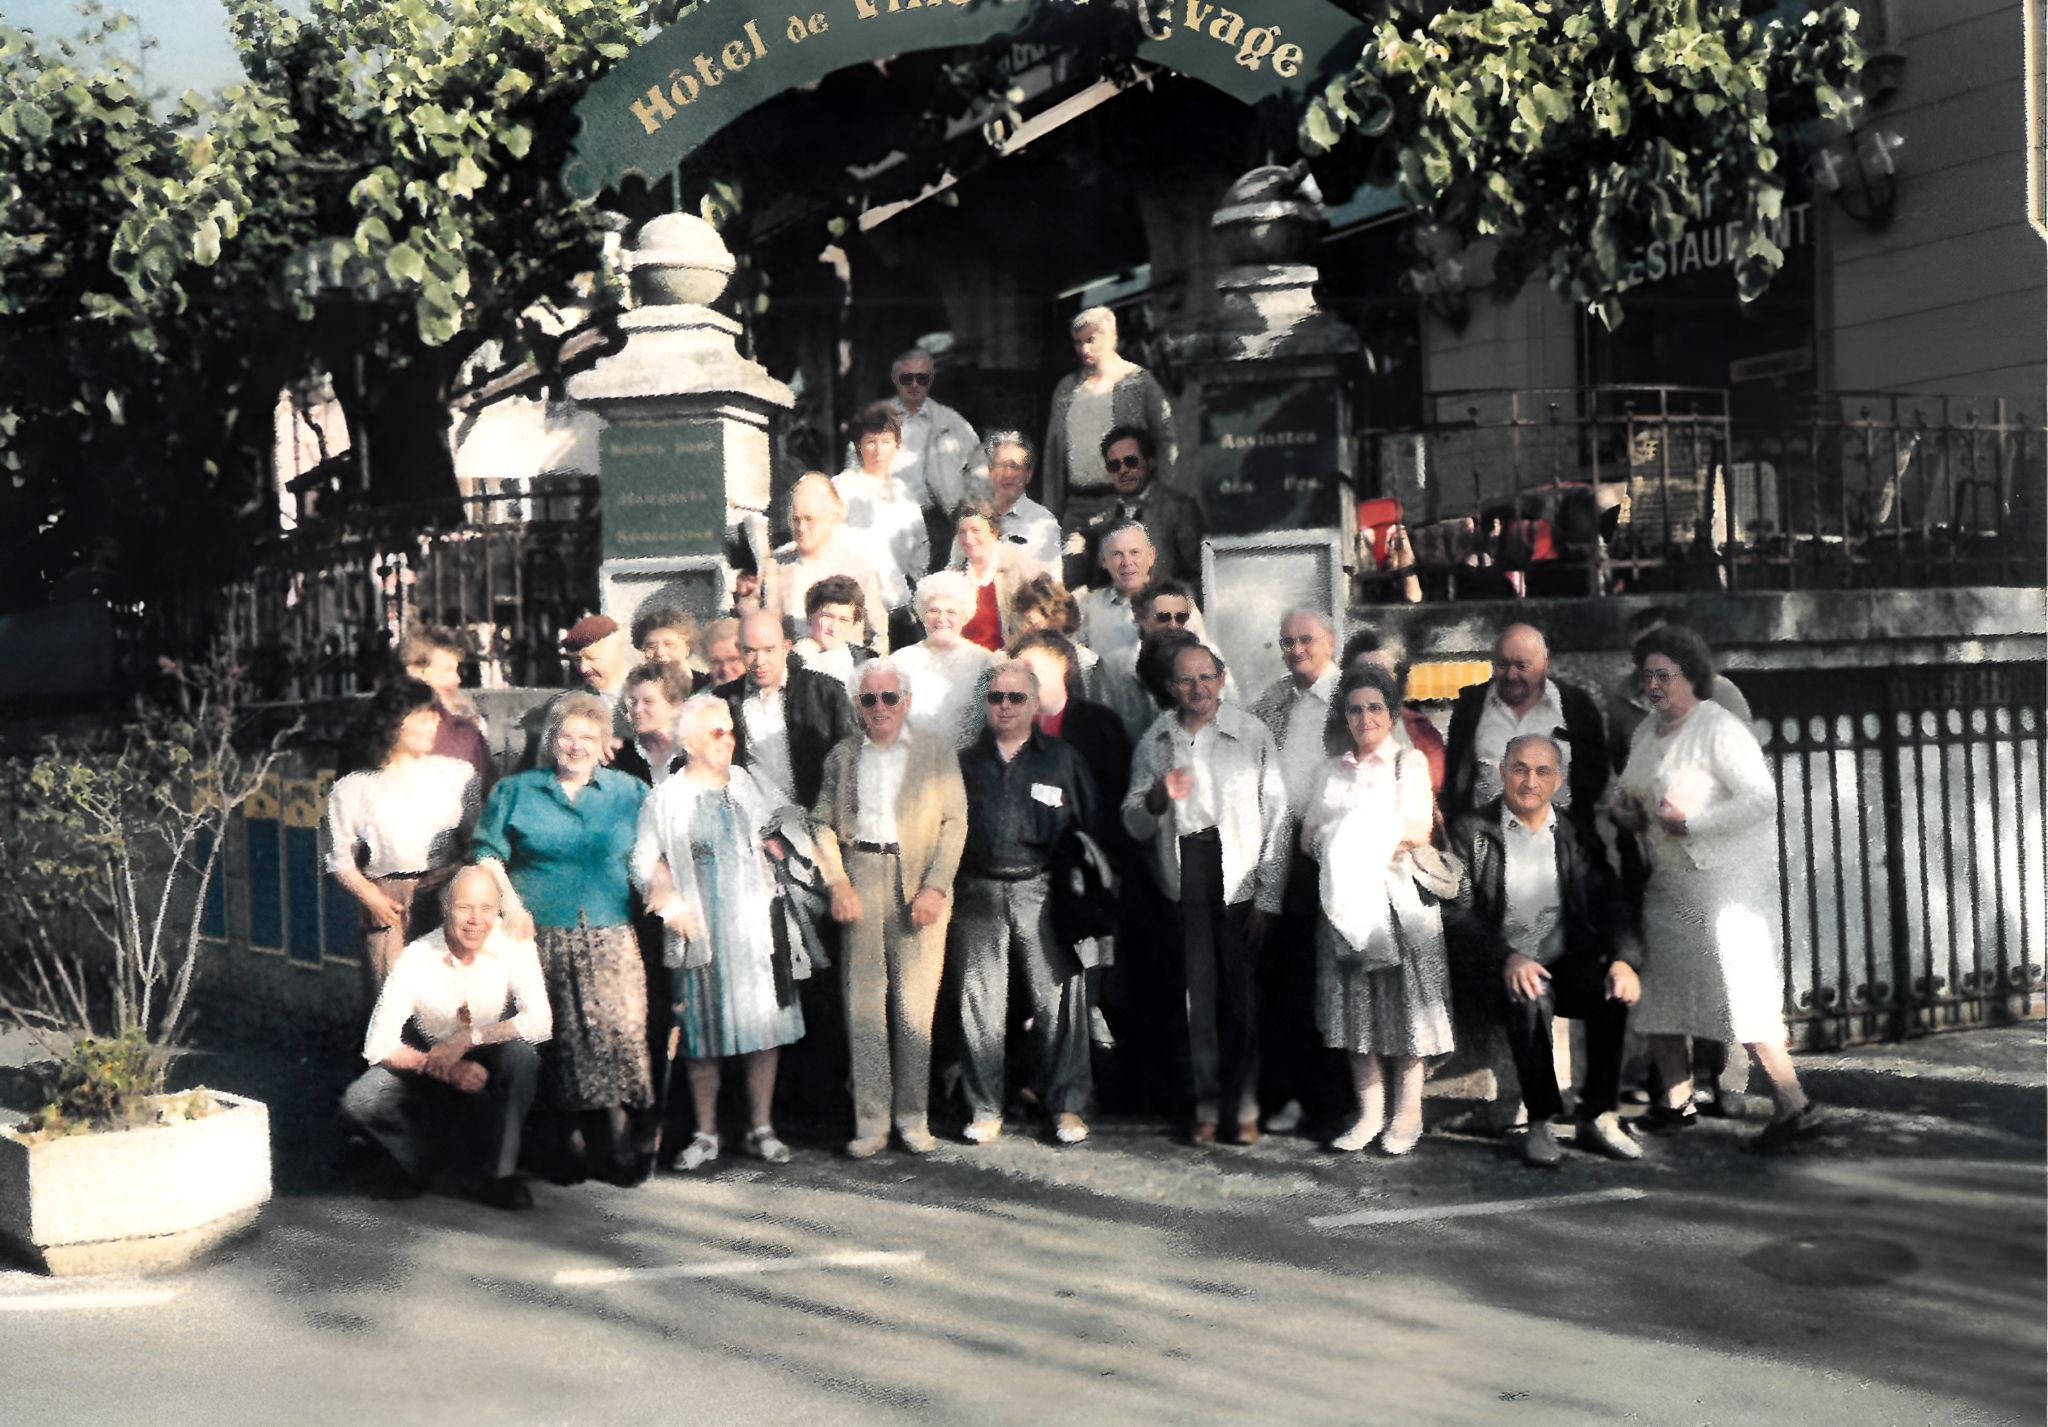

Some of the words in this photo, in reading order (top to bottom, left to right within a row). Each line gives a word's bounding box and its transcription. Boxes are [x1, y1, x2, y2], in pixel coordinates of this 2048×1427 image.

[629, 18, 768, 135] Hôtel
[787, 12, 830, 44] de
[1158, 0, 1304, 78] vage
[1625, 202, 1812, 285] ESTAUNT
